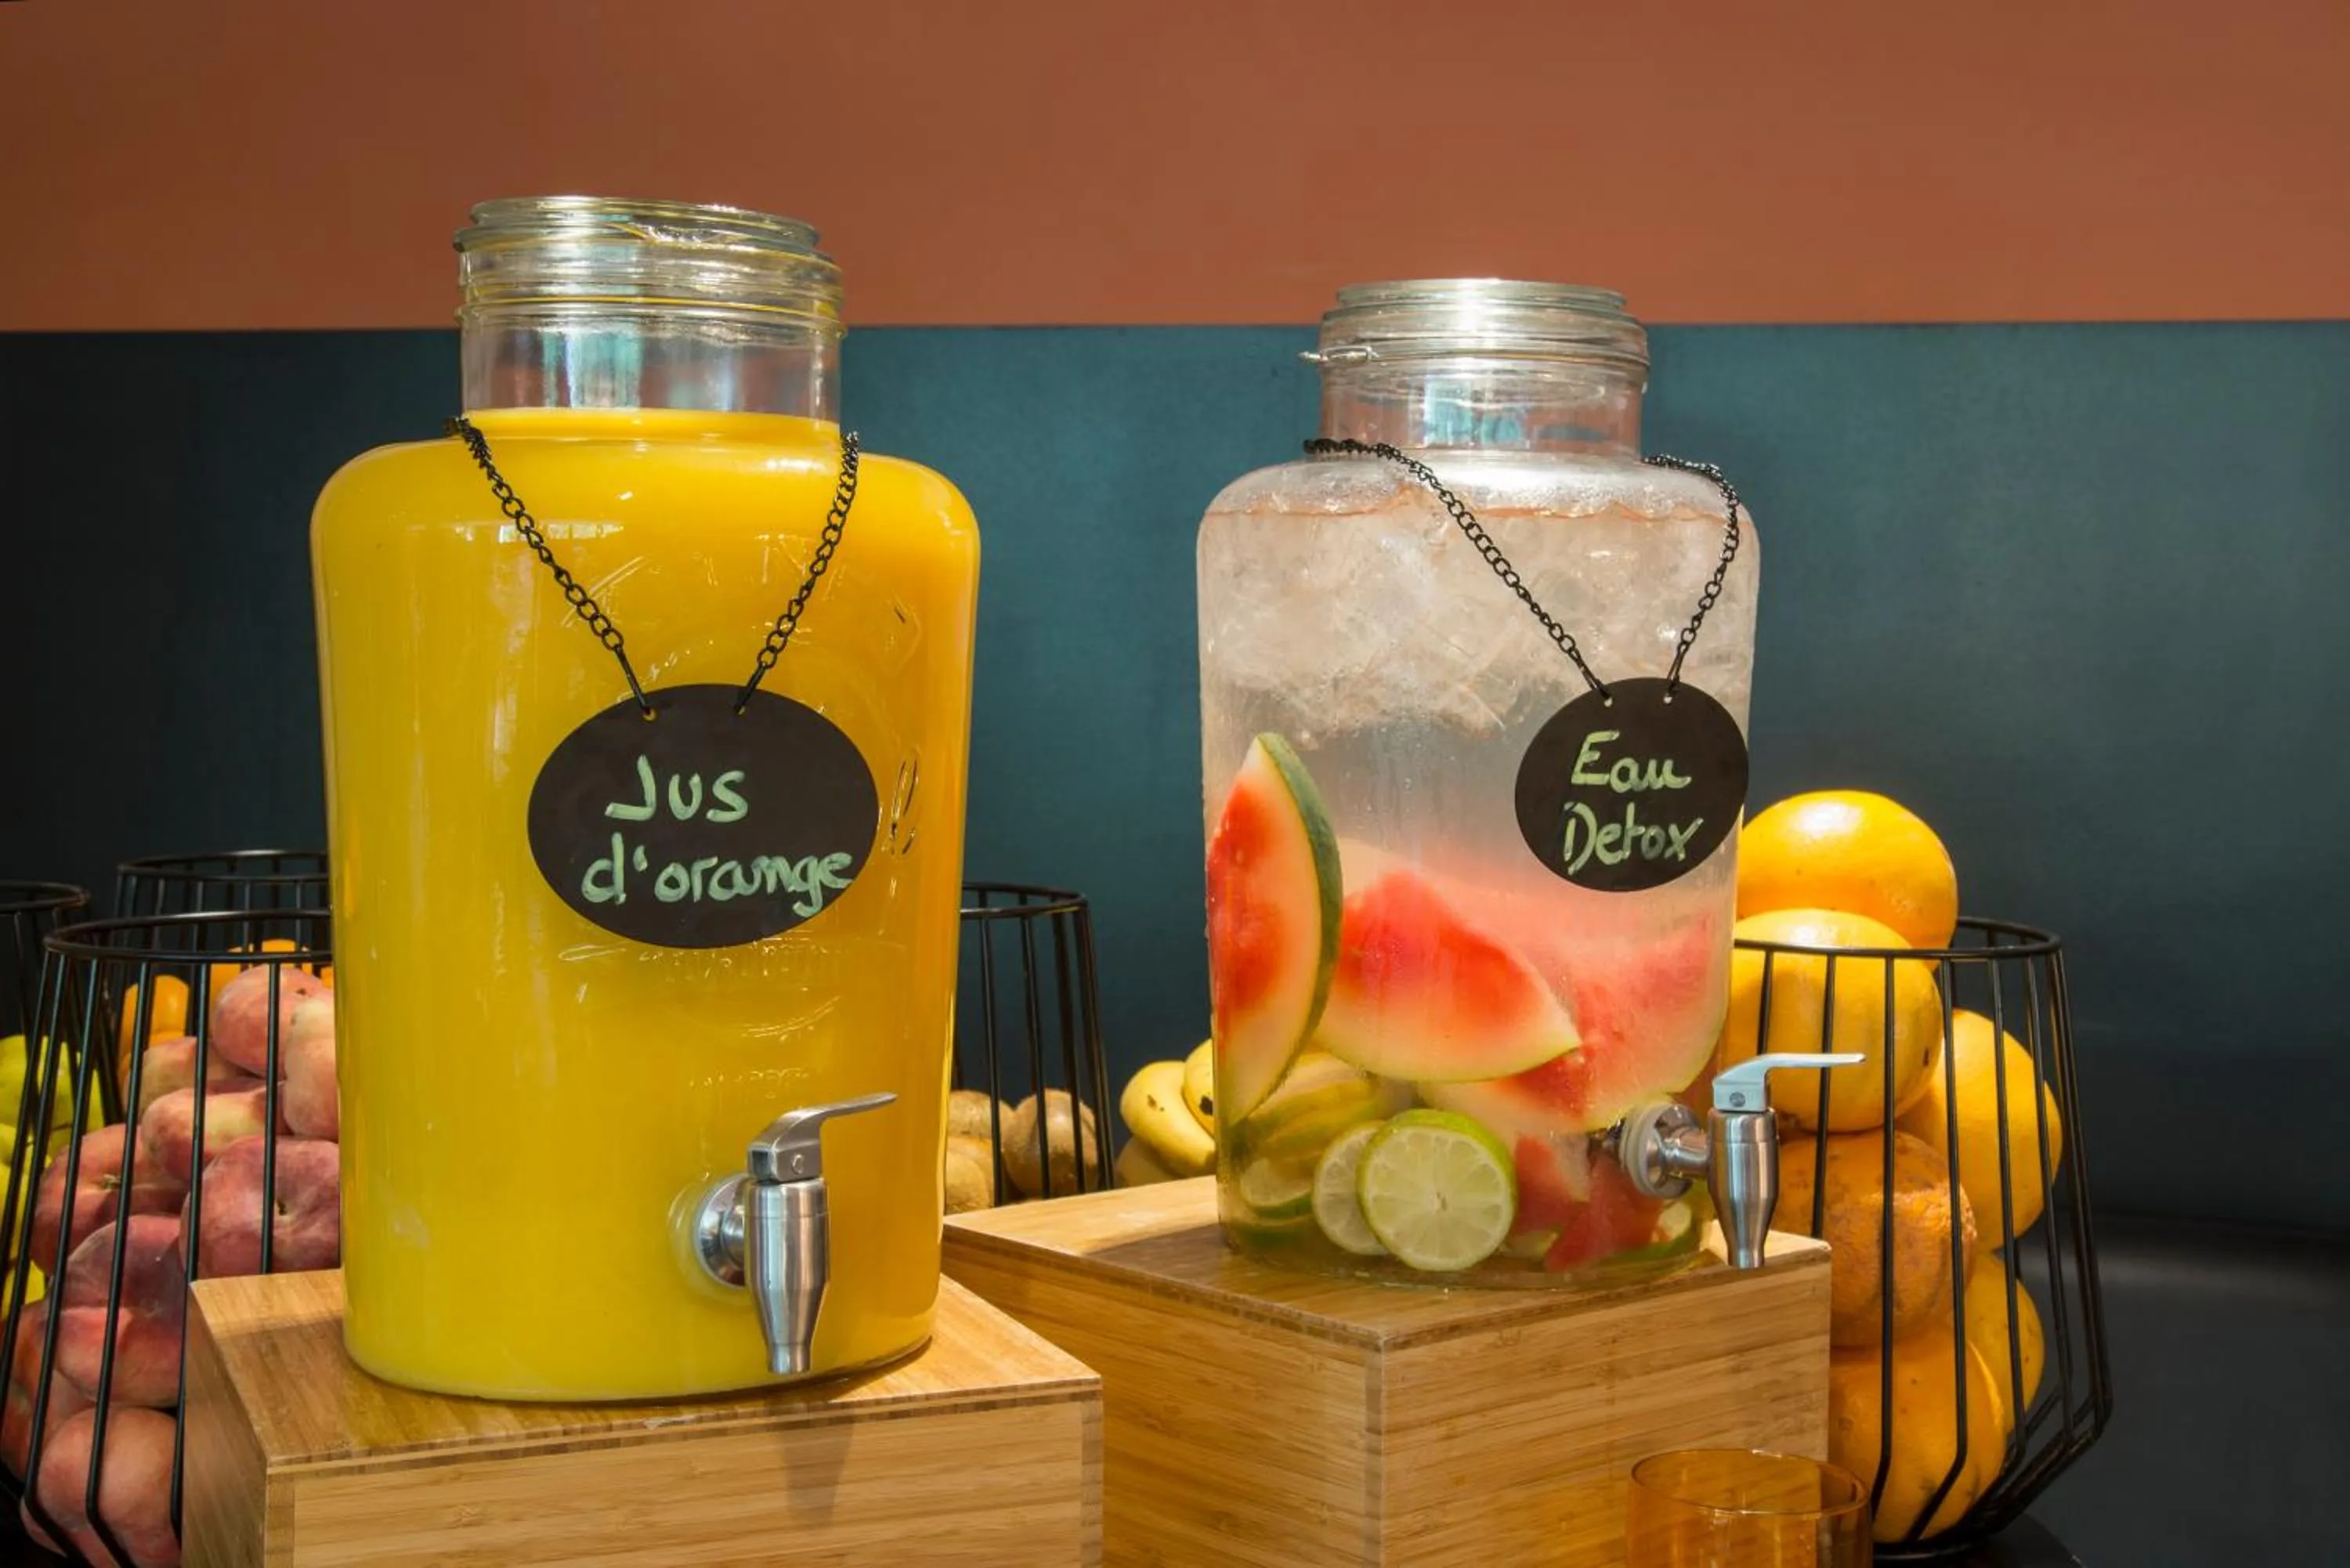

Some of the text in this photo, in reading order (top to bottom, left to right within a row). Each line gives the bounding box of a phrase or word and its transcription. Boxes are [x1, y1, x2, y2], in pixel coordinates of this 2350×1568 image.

[605, 754, 749, 822] Jus
[1571, 730, 1692, 793] Eau
[1563, 801, 1704, 875] Detox
[581, 832, 853, 918] d'orange
